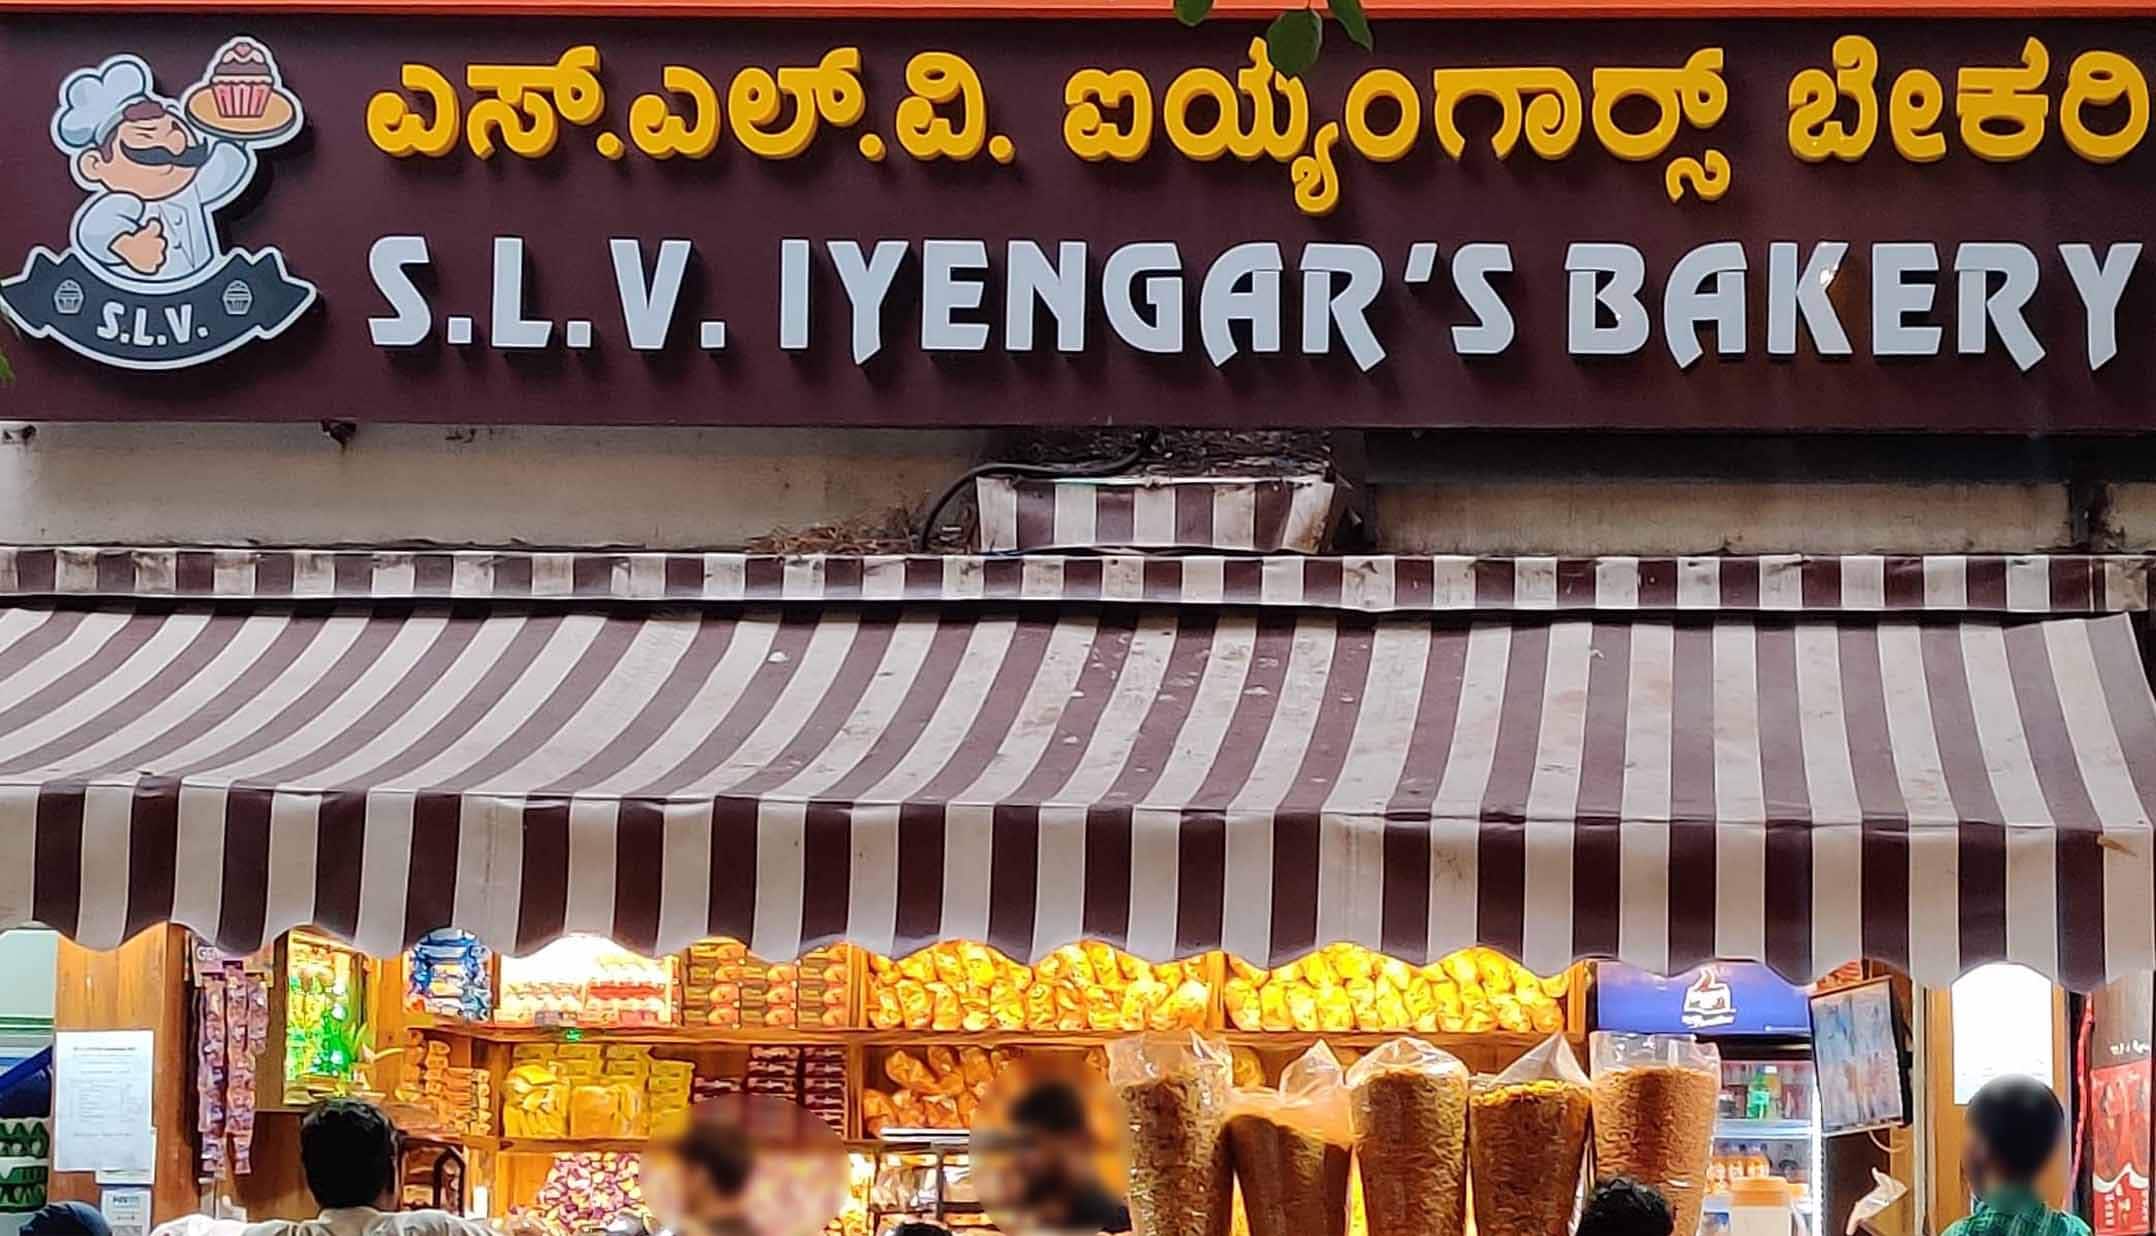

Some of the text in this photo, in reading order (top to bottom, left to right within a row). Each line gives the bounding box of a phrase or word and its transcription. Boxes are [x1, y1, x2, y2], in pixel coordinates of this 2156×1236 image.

[1787, 33, 2150, 163] ಬೇಕರಿ
[97, 302, 208, 346] S.L.V.
[368, 236, 2144, 372] S.L.V. IYENGAR'S BAKERY
